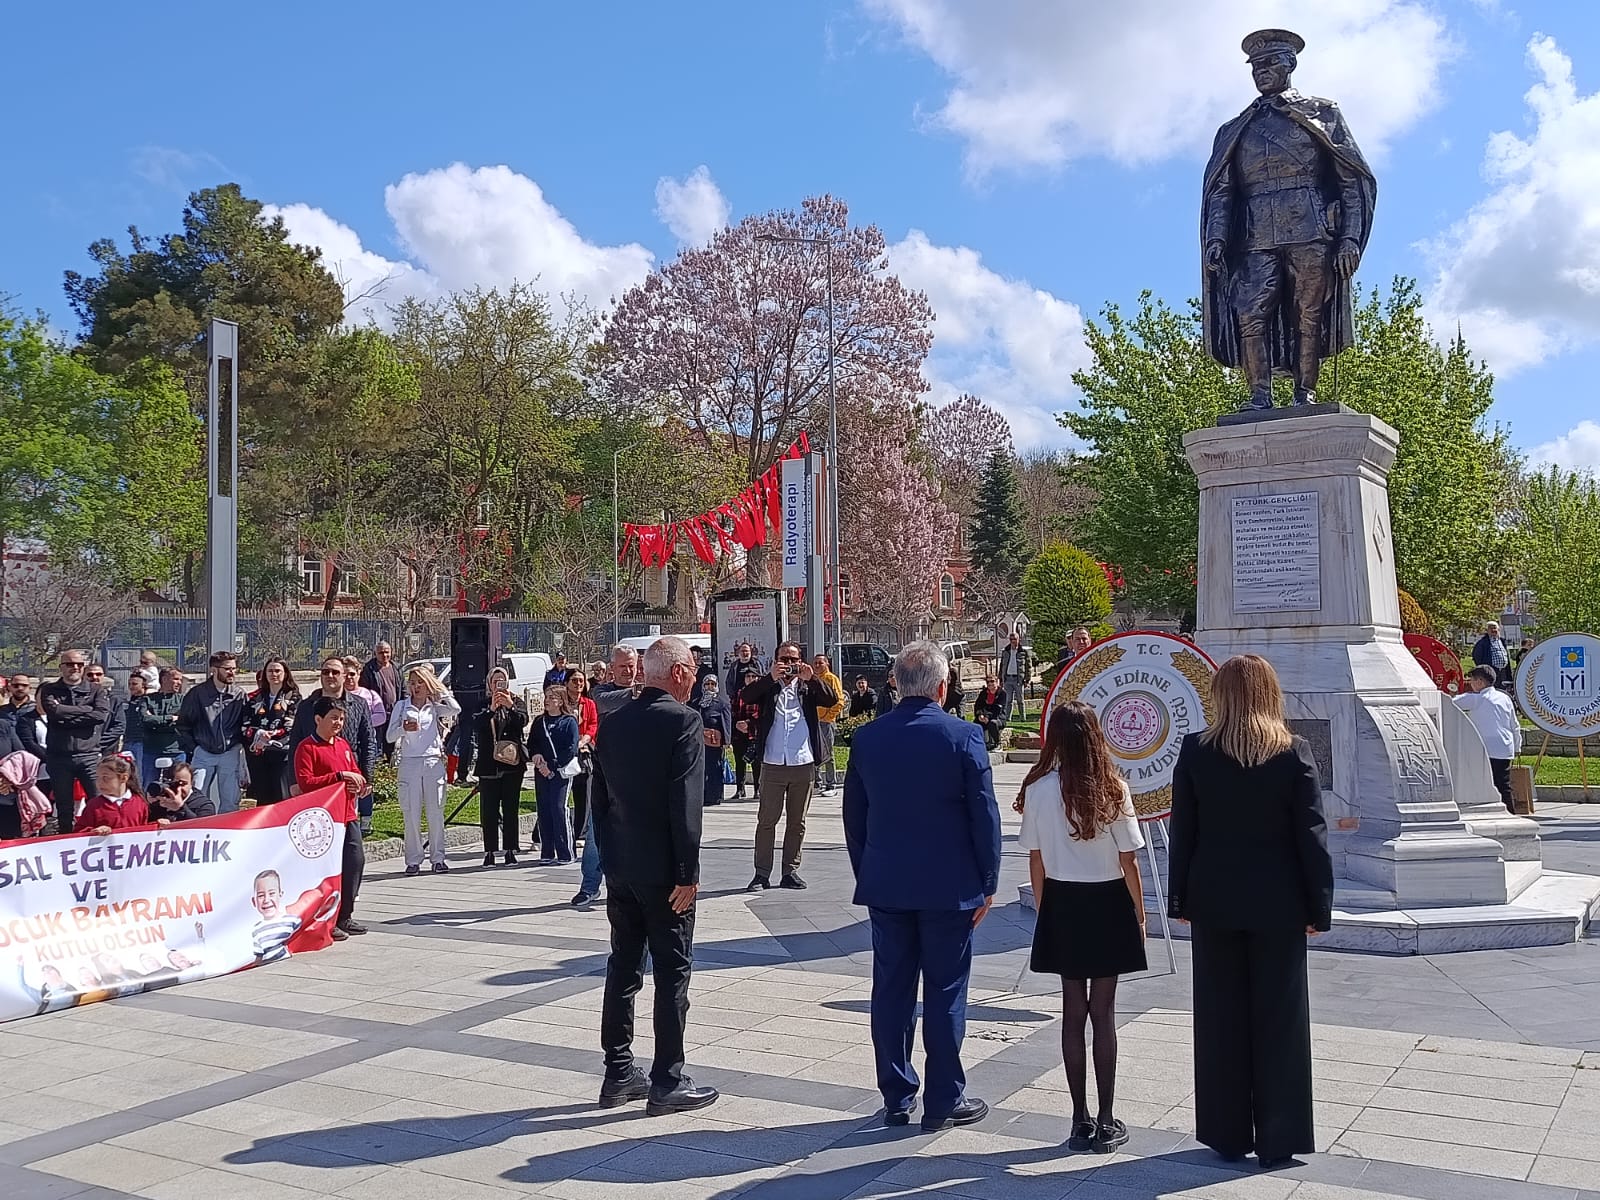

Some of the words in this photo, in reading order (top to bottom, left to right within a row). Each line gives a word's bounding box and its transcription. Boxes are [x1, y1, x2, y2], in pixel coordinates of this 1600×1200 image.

[785, 483, 799, 565] Radyoterapi
[1136, 643, 1163, 656] T.C.
[1114, 669, 1172, 693] EDİRNE
[1560, 670, 1585, 690] İYİ
[1537, 684, 1559, 712] EDİRNE
[1559, 704, 1567, 715] İL
[69, 878, 108, 902] VE
[71, 891, 214, 928] BAYRAMI
[35, 937, 99, 962] KUTLU
[103, 924, 166, 951] OLSUN
